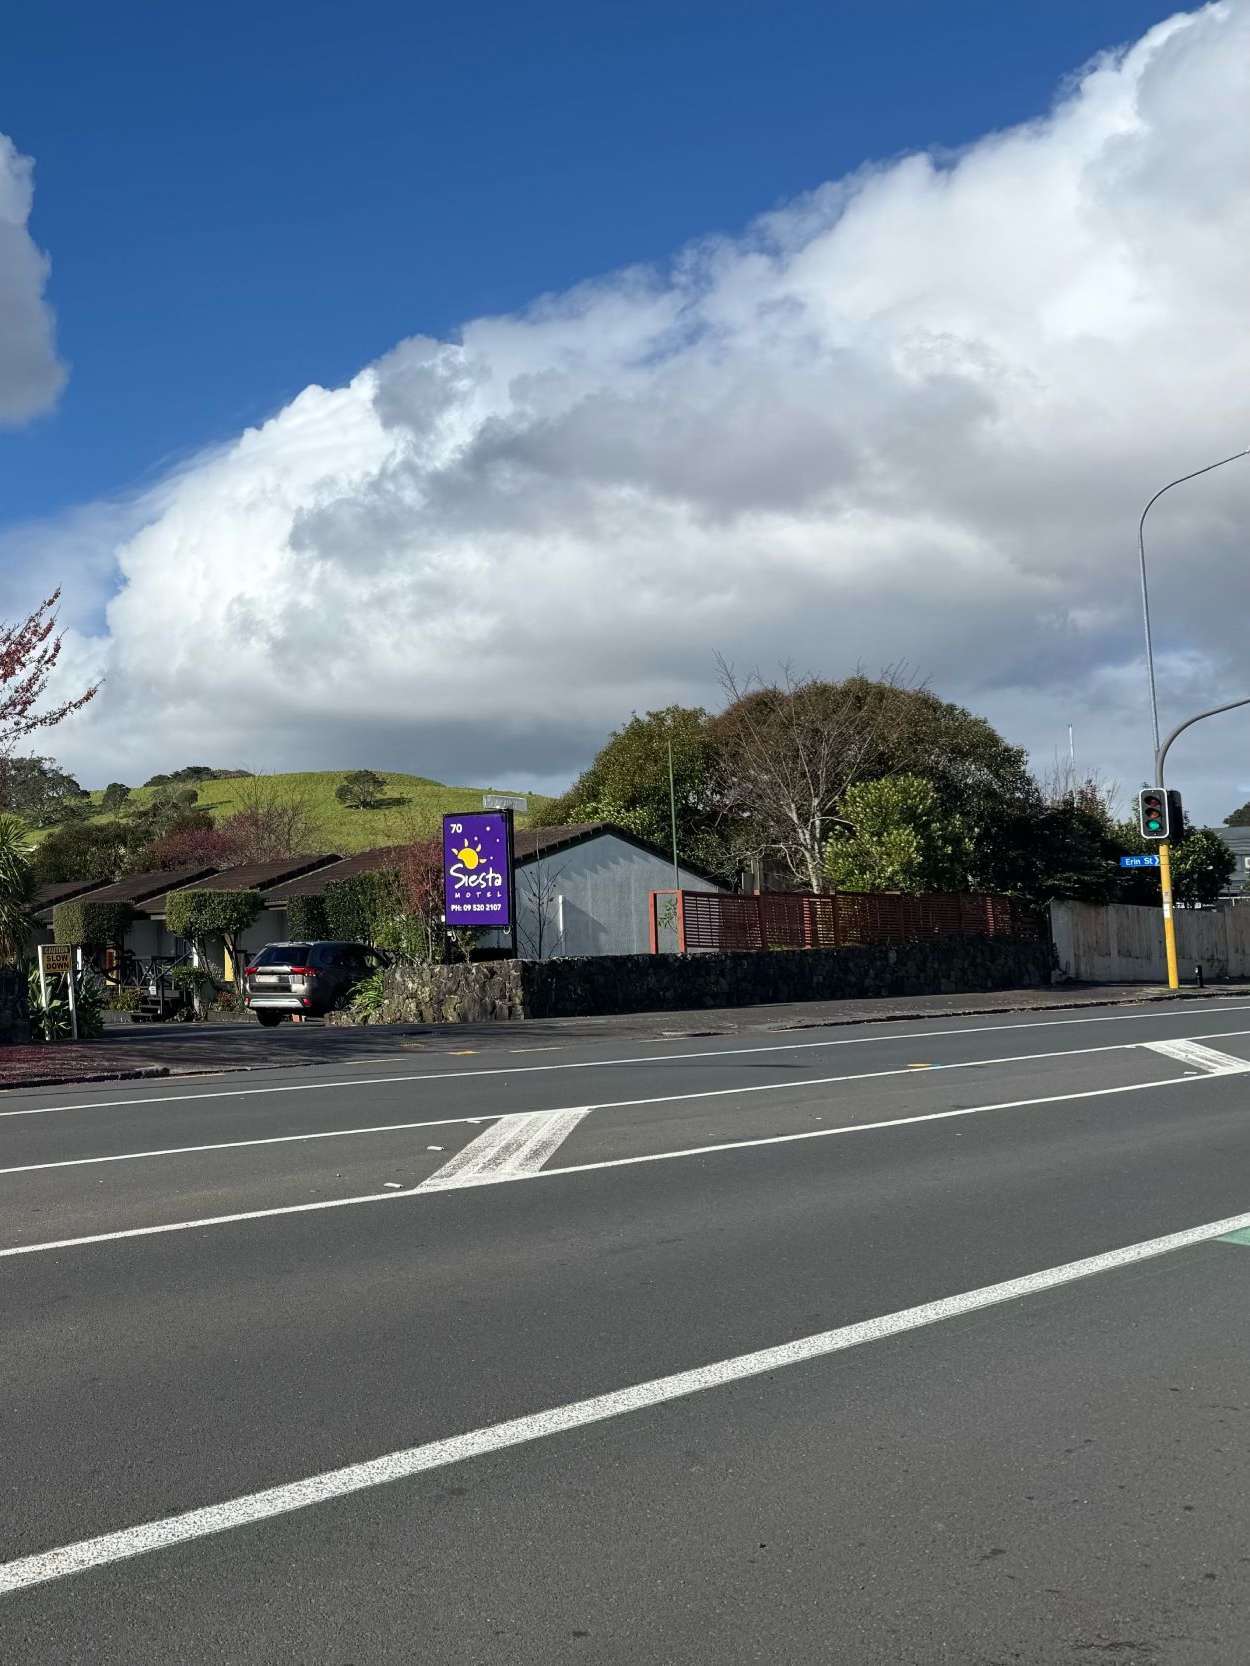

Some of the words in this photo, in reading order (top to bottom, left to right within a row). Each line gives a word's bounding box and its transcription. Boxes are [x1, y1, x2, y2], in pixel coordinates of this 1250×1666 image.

[450, 823, 462, 833] 70
[1125, 858, 1141, 866] Erin
[1144, 857, 1153, 865] St
[449, 863, 502, 889] Siesta
[47, 962, 69, 970] DOWN
